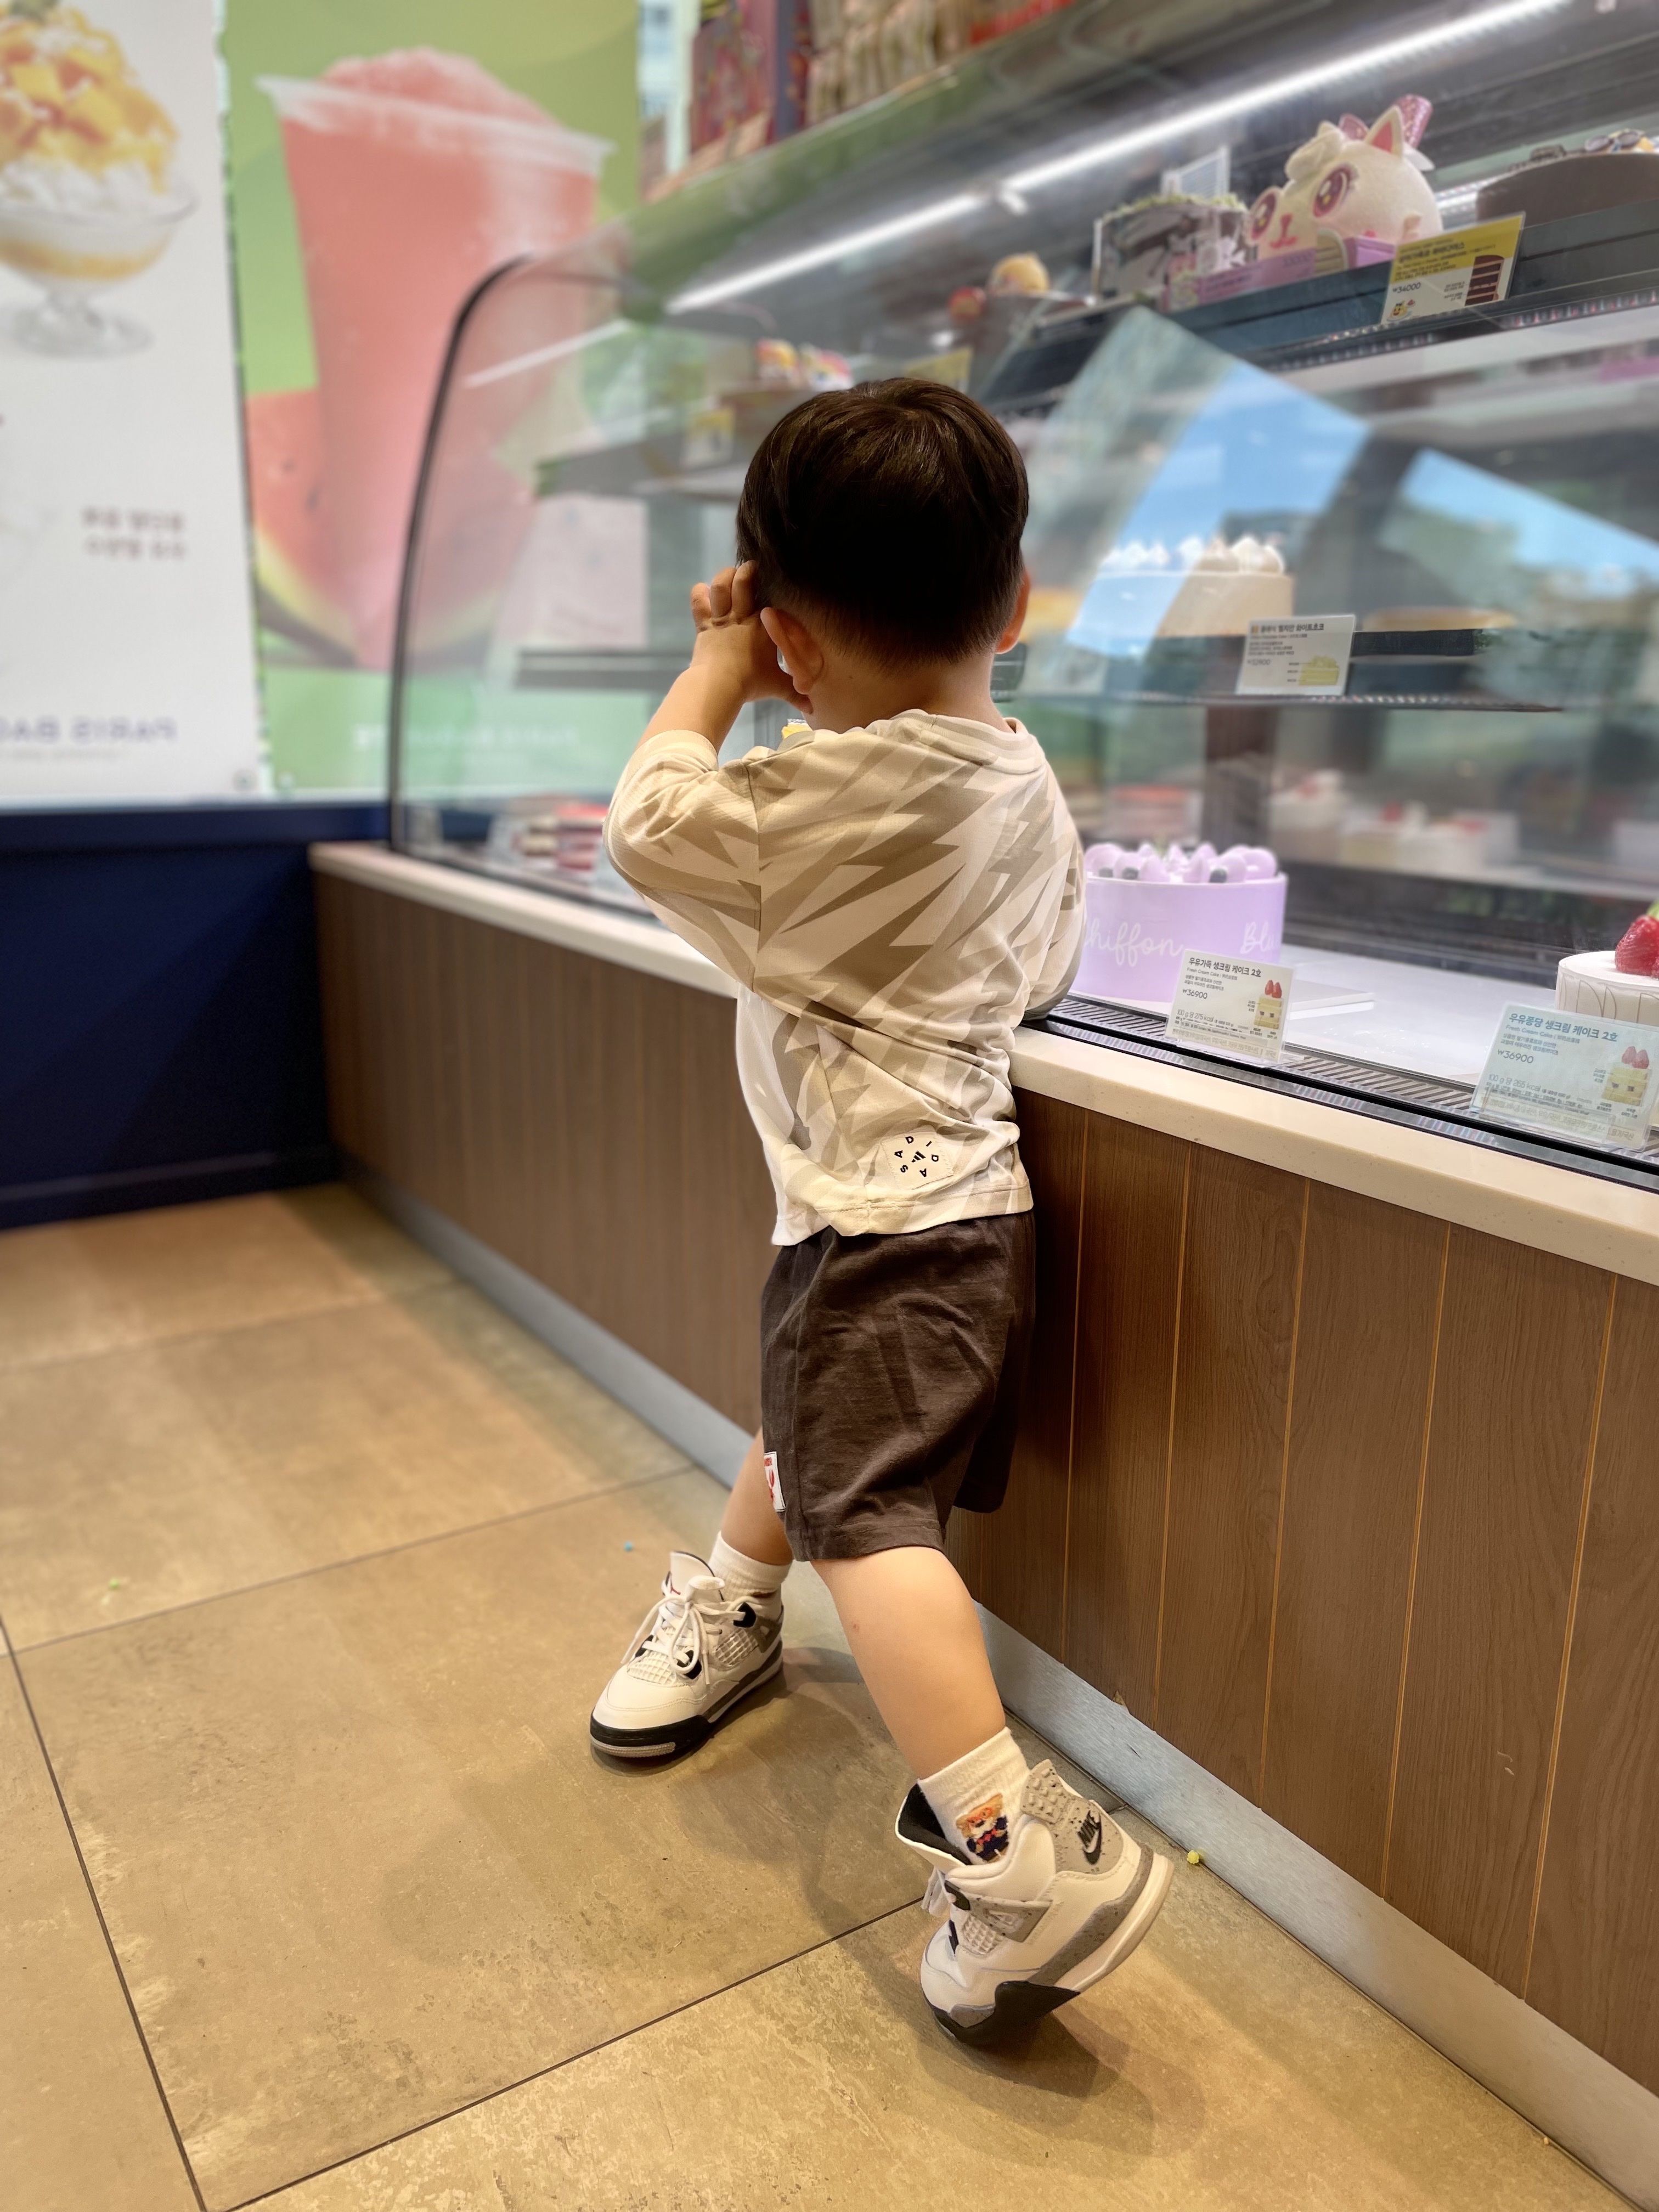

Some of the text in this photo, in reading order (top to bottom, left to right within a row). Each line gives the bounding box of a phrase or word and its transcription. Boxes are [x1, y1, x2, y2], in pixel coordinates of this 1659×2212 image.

[1392, 282, 1421, 294] ₩34000
[1189, 957, 1261, 977] 우유가득 생크림 케이크 2호
[1182, 989, 1207, 999] ₩36900
[1509, 1013, 1618, 1042] 우유퐁당 생크림 케이크 2호
[1497, 1049, 1534, 1063] ₩36900
[1489, 1074, 1499, 1082] 100
[1513, 1079, 1526, 1088] 265
[1526, 1082, 1542, 1092] kcal
[1077, 1810, 1101, 1849] NIKE
